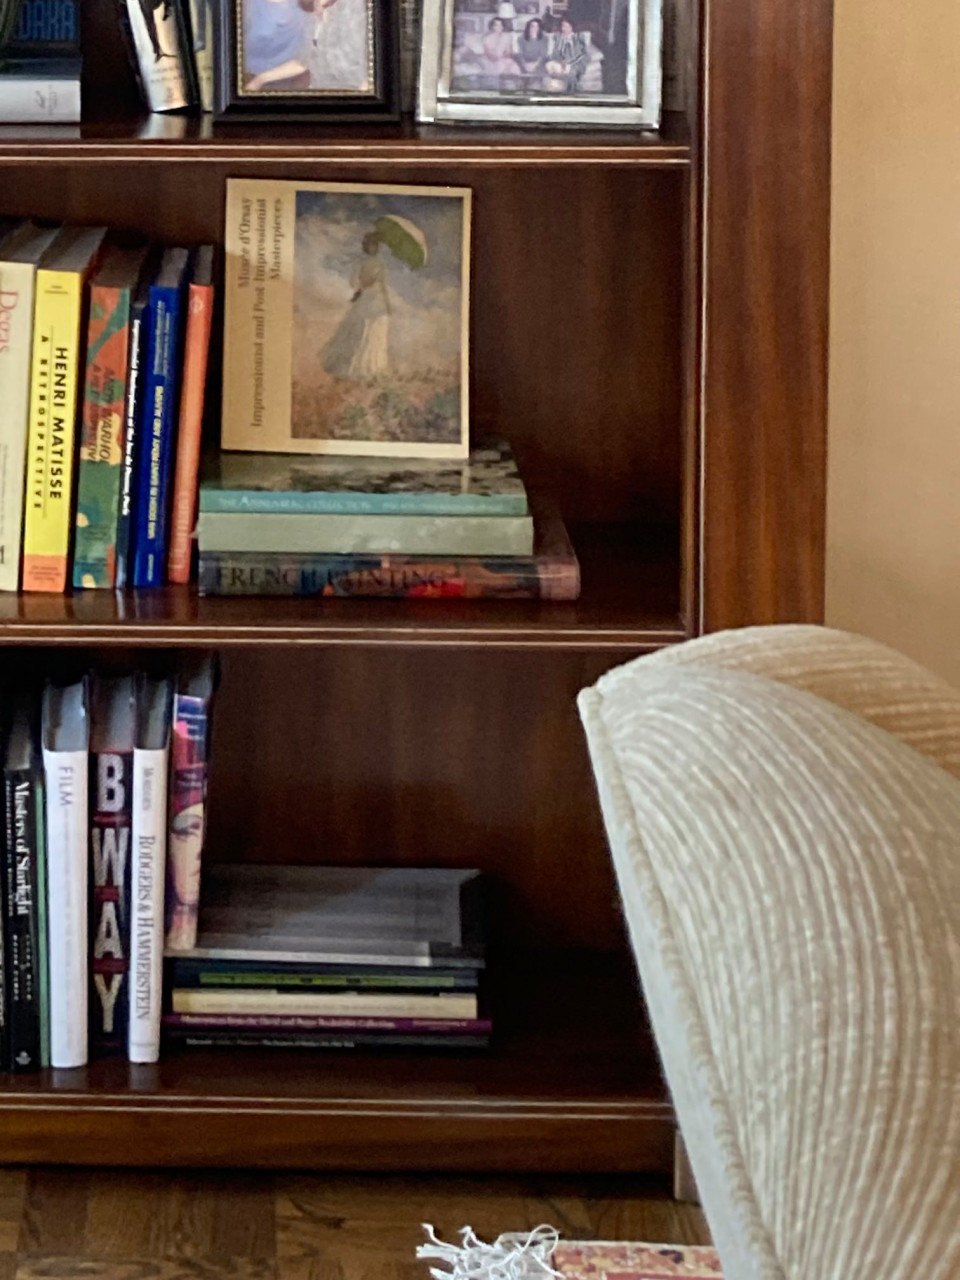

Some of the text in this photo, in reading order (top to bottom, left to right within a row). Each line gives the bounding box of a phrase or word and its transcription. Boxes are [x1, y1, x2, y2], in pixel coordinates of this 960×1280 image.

[19, 0, 75, 39] DAKA
[269, 198, 285, 280] Masterpieces
[252, 316, 265, 339] and
[250, 342, 265, 427] Impressionist
[33, 335, 50, 509] A RETROSPECTIVE
[49, 347, 69, 500] HENRI MATISSE
[14, 781, 30, 837] Masters
[58, 766, 74, 807] FILM
[15, 839, 30, 855] of
[138, 835, 156, 900] RODGERS
[13, 856, 33, 916] Starlight
[136, 917, 155, 1020] HAMMERSTEIN
